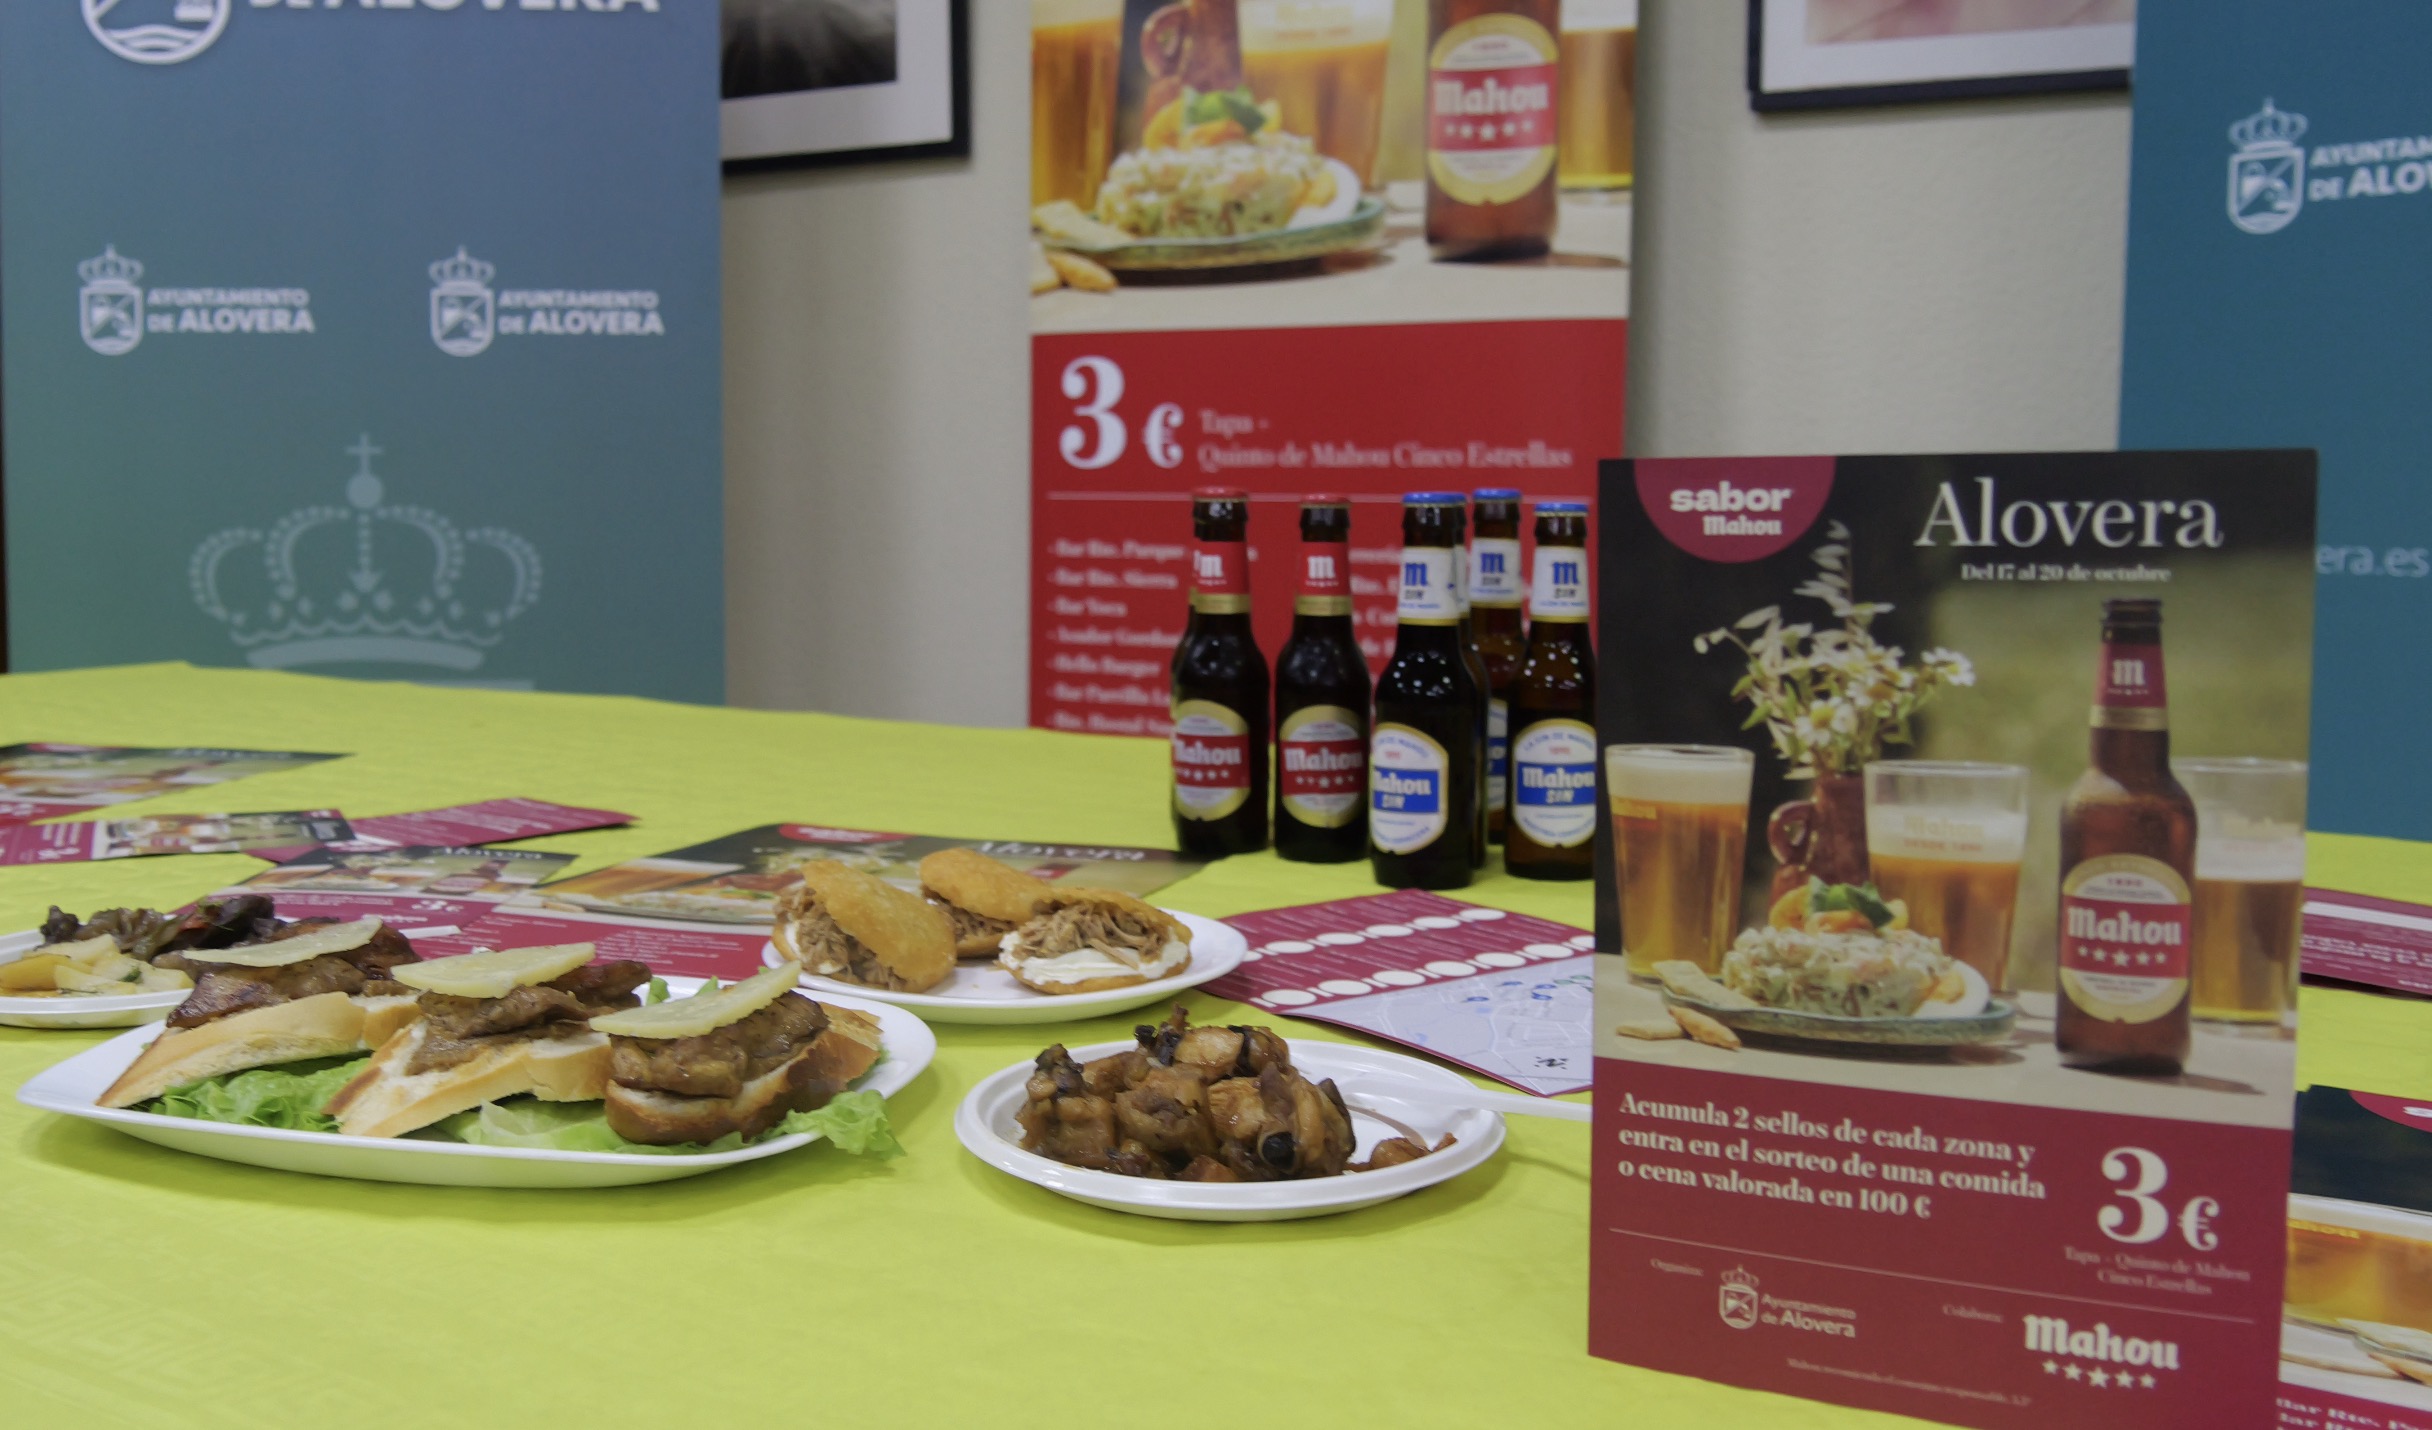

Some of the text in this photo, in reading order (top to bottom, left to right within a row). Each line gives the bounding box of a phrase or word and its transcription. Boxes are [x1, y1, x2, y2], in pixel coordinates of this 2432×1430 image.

[2347, 160, 2432, 198] ALO
[147, 288, 310, 307] AYUNTAMIENTO
[498, 290, 660, 309] AYUNTAMIENTO
[147, 309, 315, 333] DE ALOVERA
[498, 310, 665, 336] DE ALOVERA
[1059, 355, 1184, 470] 3 €
[1278, 441, 1307, 468] de
[1466, 439, 1573, 468] Estrellas
[1670, 480, 1792, 512] sabor
[1702, 514, 1783, 536] Mahou
[1913, 476, 2224, 548] Alovera
[1961, 562, 1994, 581] Del
[2017, 563, 2037, 581] al
[2040, 563, 2063, 582] 20
[2067, 564, 2092, 582] de
[2095, 564, 2171, 583] octubre
[1522, 767, 1596, 788] Mahou
[2067, 906, 2182, 946] Mahou
[1618, 1091, 2036, 1168] Acumula 2 sellos de cada zona y
[1618, 1127, 2047, 1200] entra en el sorteo de una comida
[1618, 1160, 1932, 1219] o cena valorada en 100 €
[2097, 1146, 2220, 1251] 3 €
[1761, 1293, 1857, 1320] Ayuntamiento
[1761, 1309, 1857, 1338] de Alovera
[2023, 1313, 2180, 1371] Mahou
